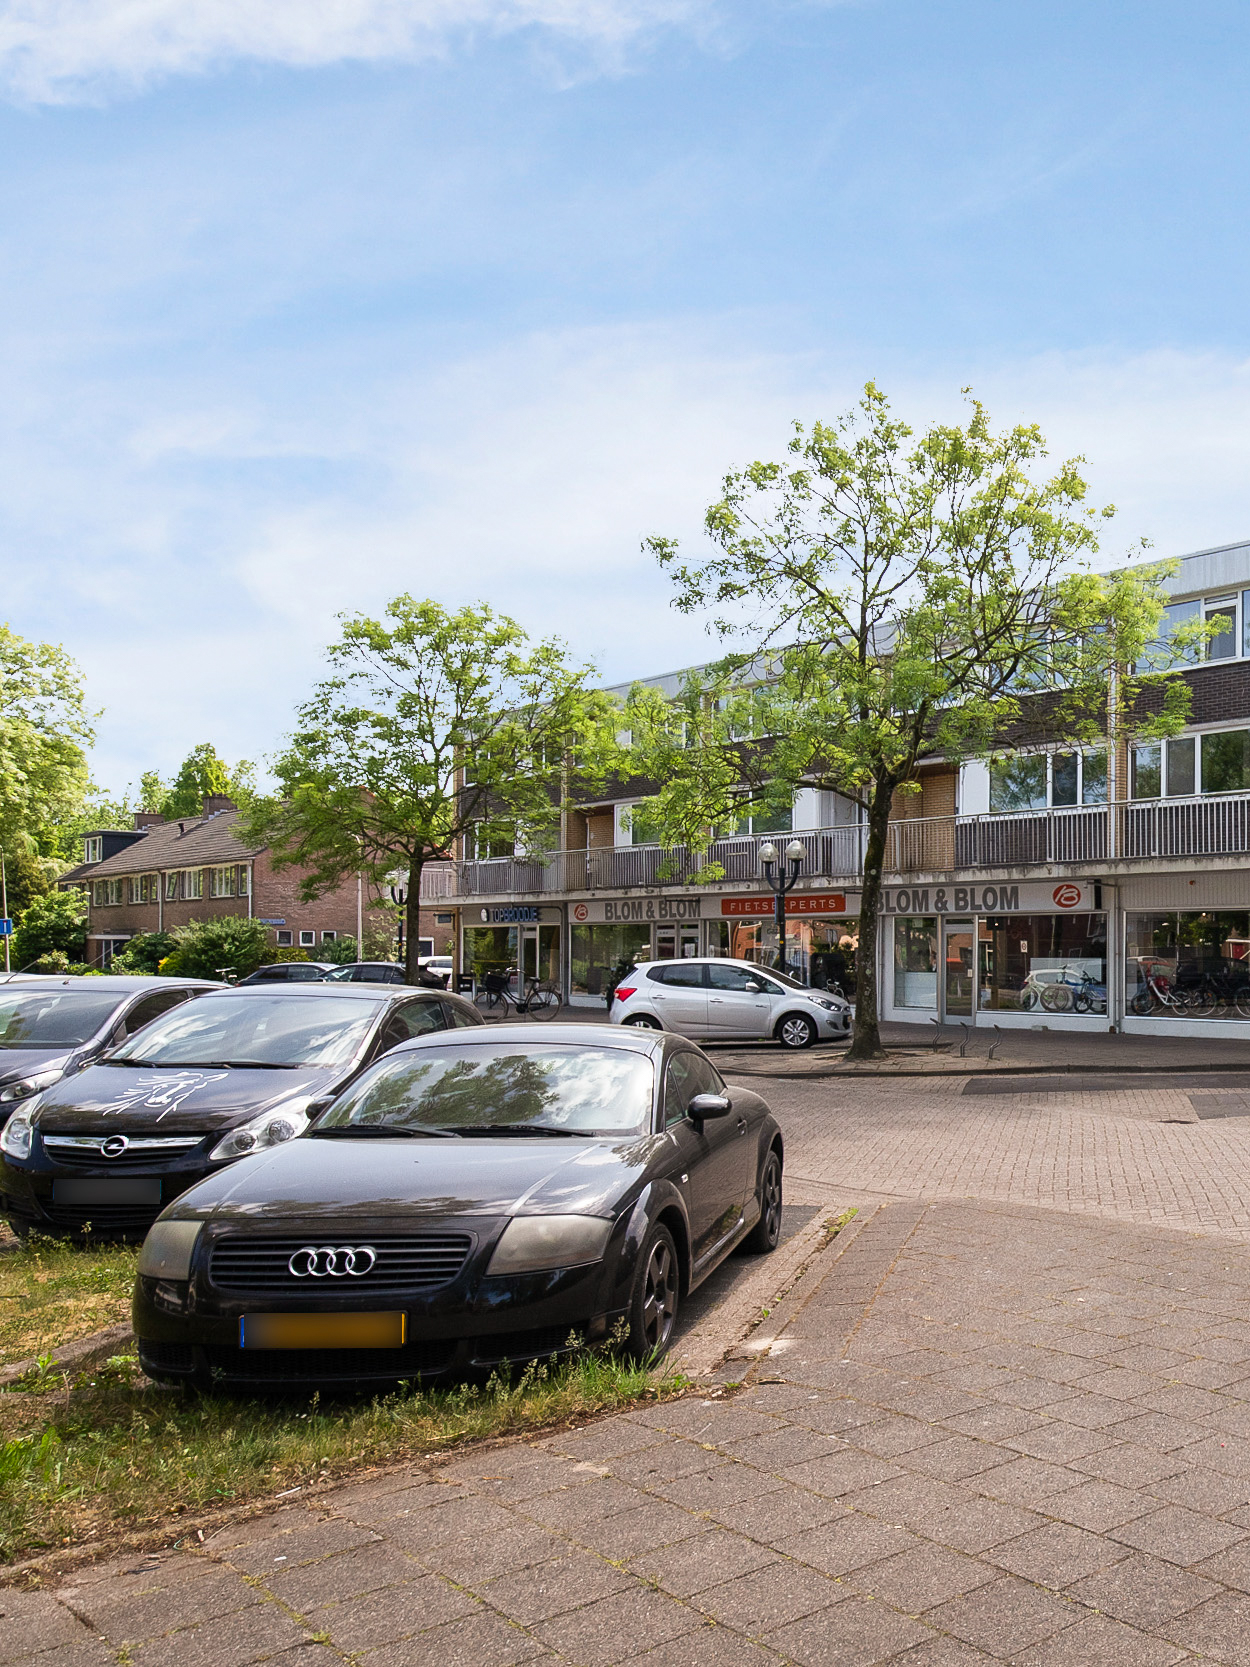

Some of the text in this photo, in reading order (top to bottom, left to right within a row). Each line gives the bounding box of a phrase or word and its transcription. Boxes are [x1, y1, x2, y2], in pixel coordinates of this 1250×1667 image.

[605, 899, 700, 920] BLOM & BLOM
[730, 899, 836, 911] FIETSEPERTS
[934, 889, 948, 912] &
[954, 886, 1019, 911] BLOM
